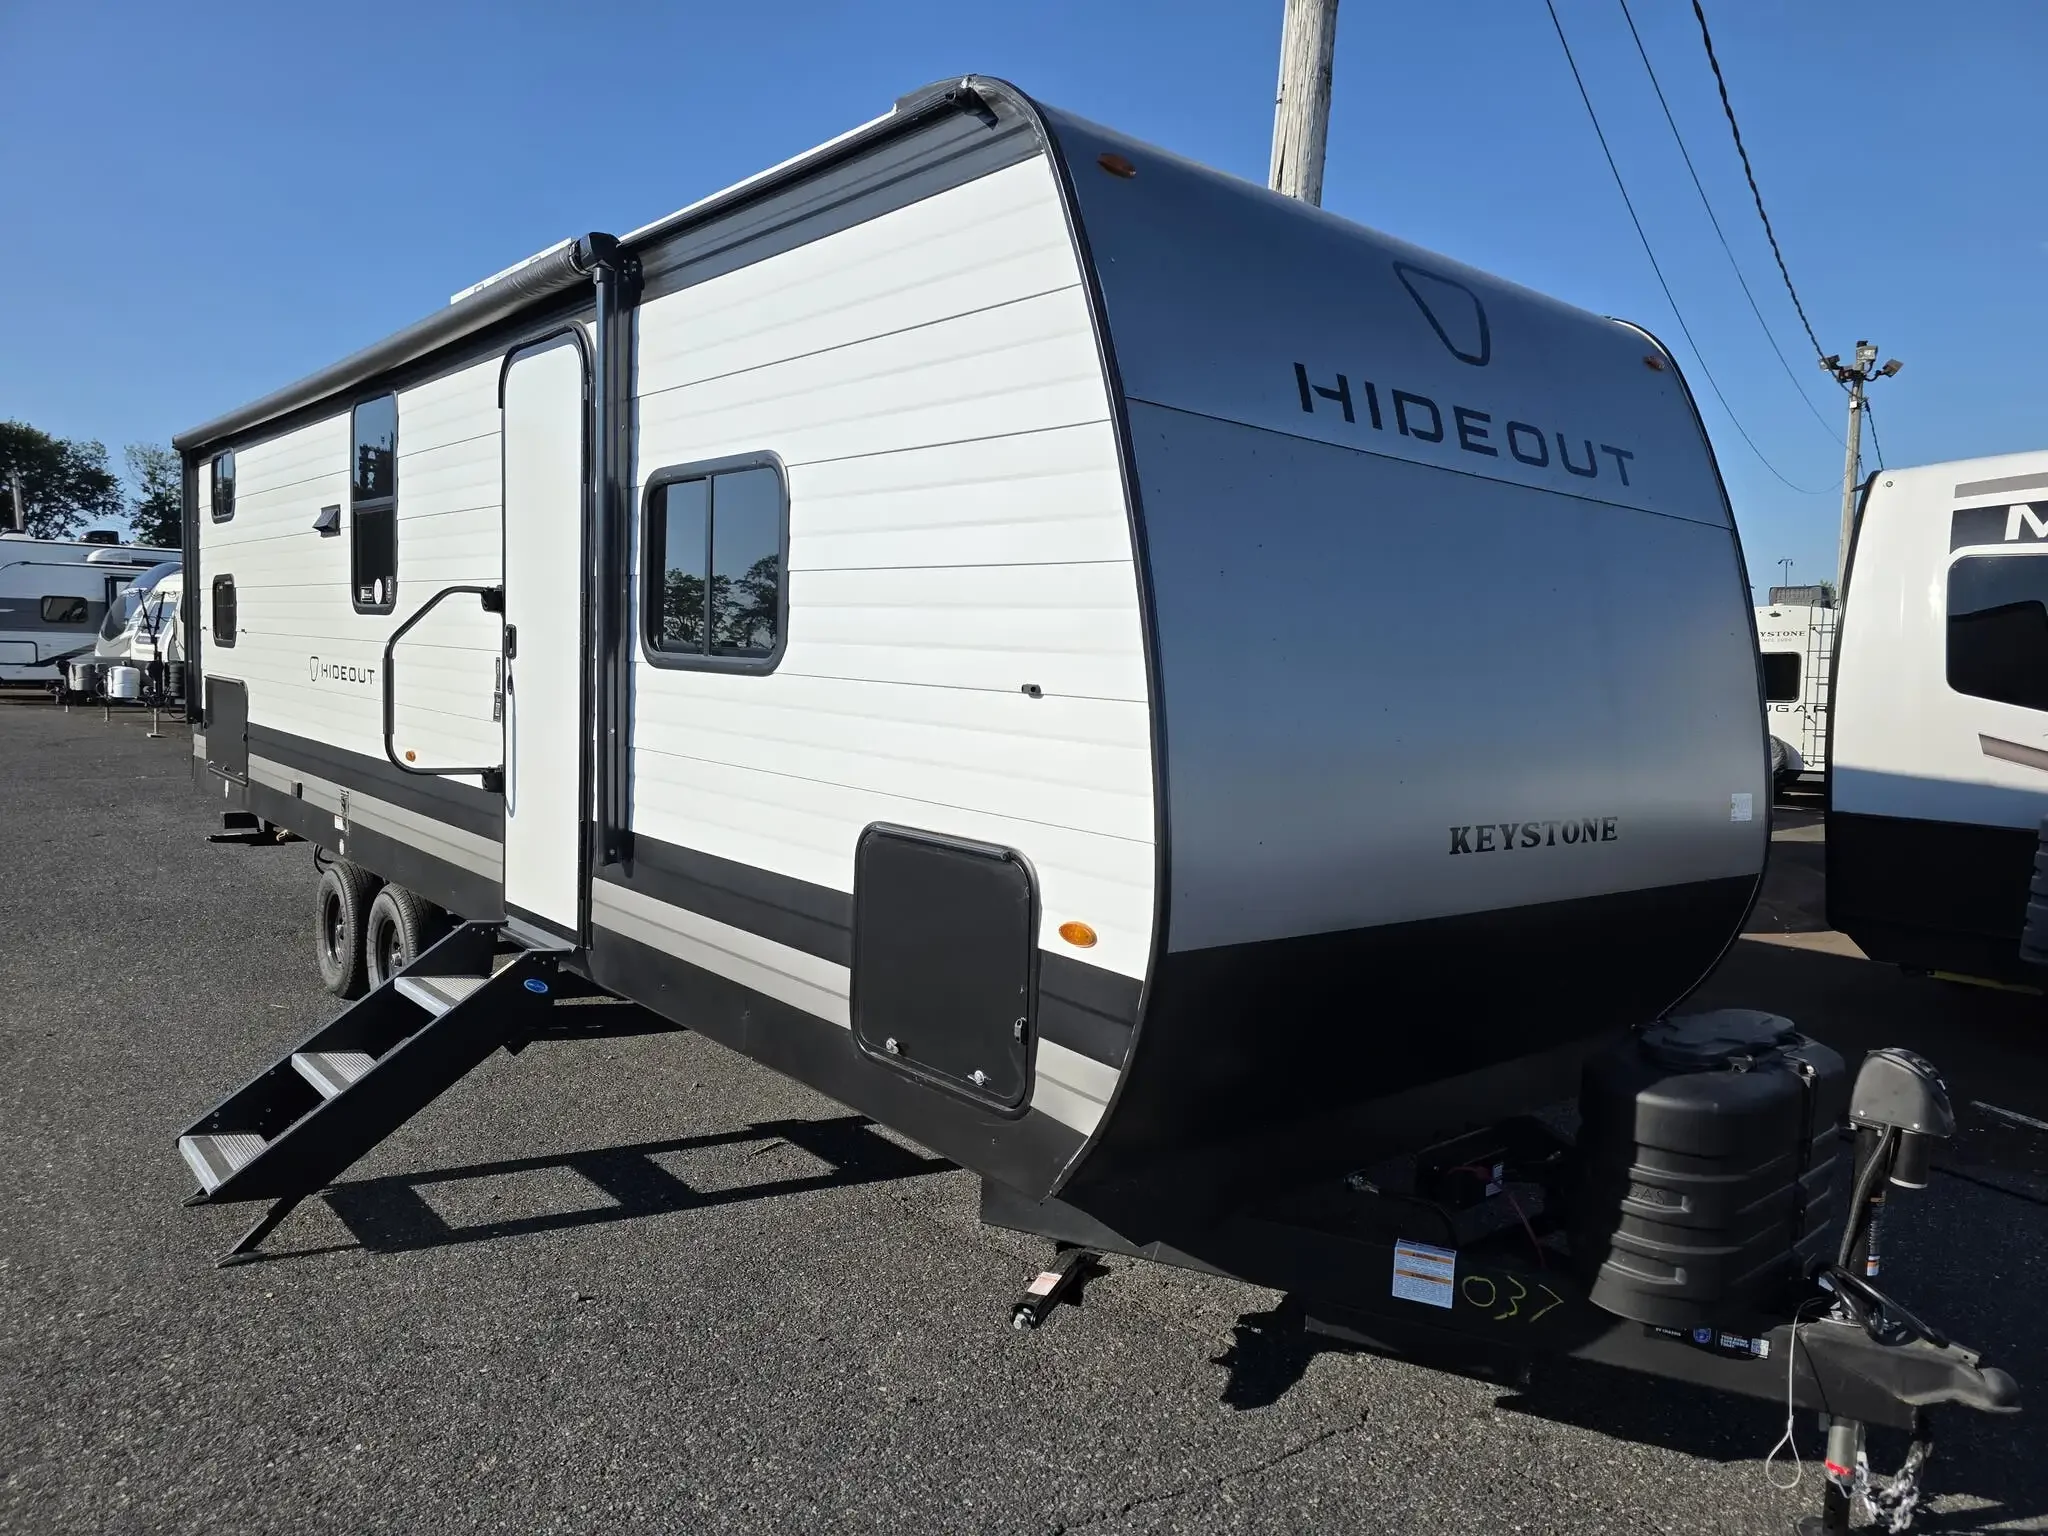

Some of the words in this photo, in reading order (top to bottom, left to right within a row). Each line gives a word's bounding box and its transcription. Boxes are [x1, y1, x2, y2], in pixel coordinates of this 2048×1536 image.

[1293, 361, 1635, 487] HIDEOUT
[1760, 630, 1806, 638] YSTONE
[320, 663, 376, 685] HIDEOUT
[1449, 816, 1619, 856] KEYSTONE
[1461, 1274, 1565, 1323] 037
